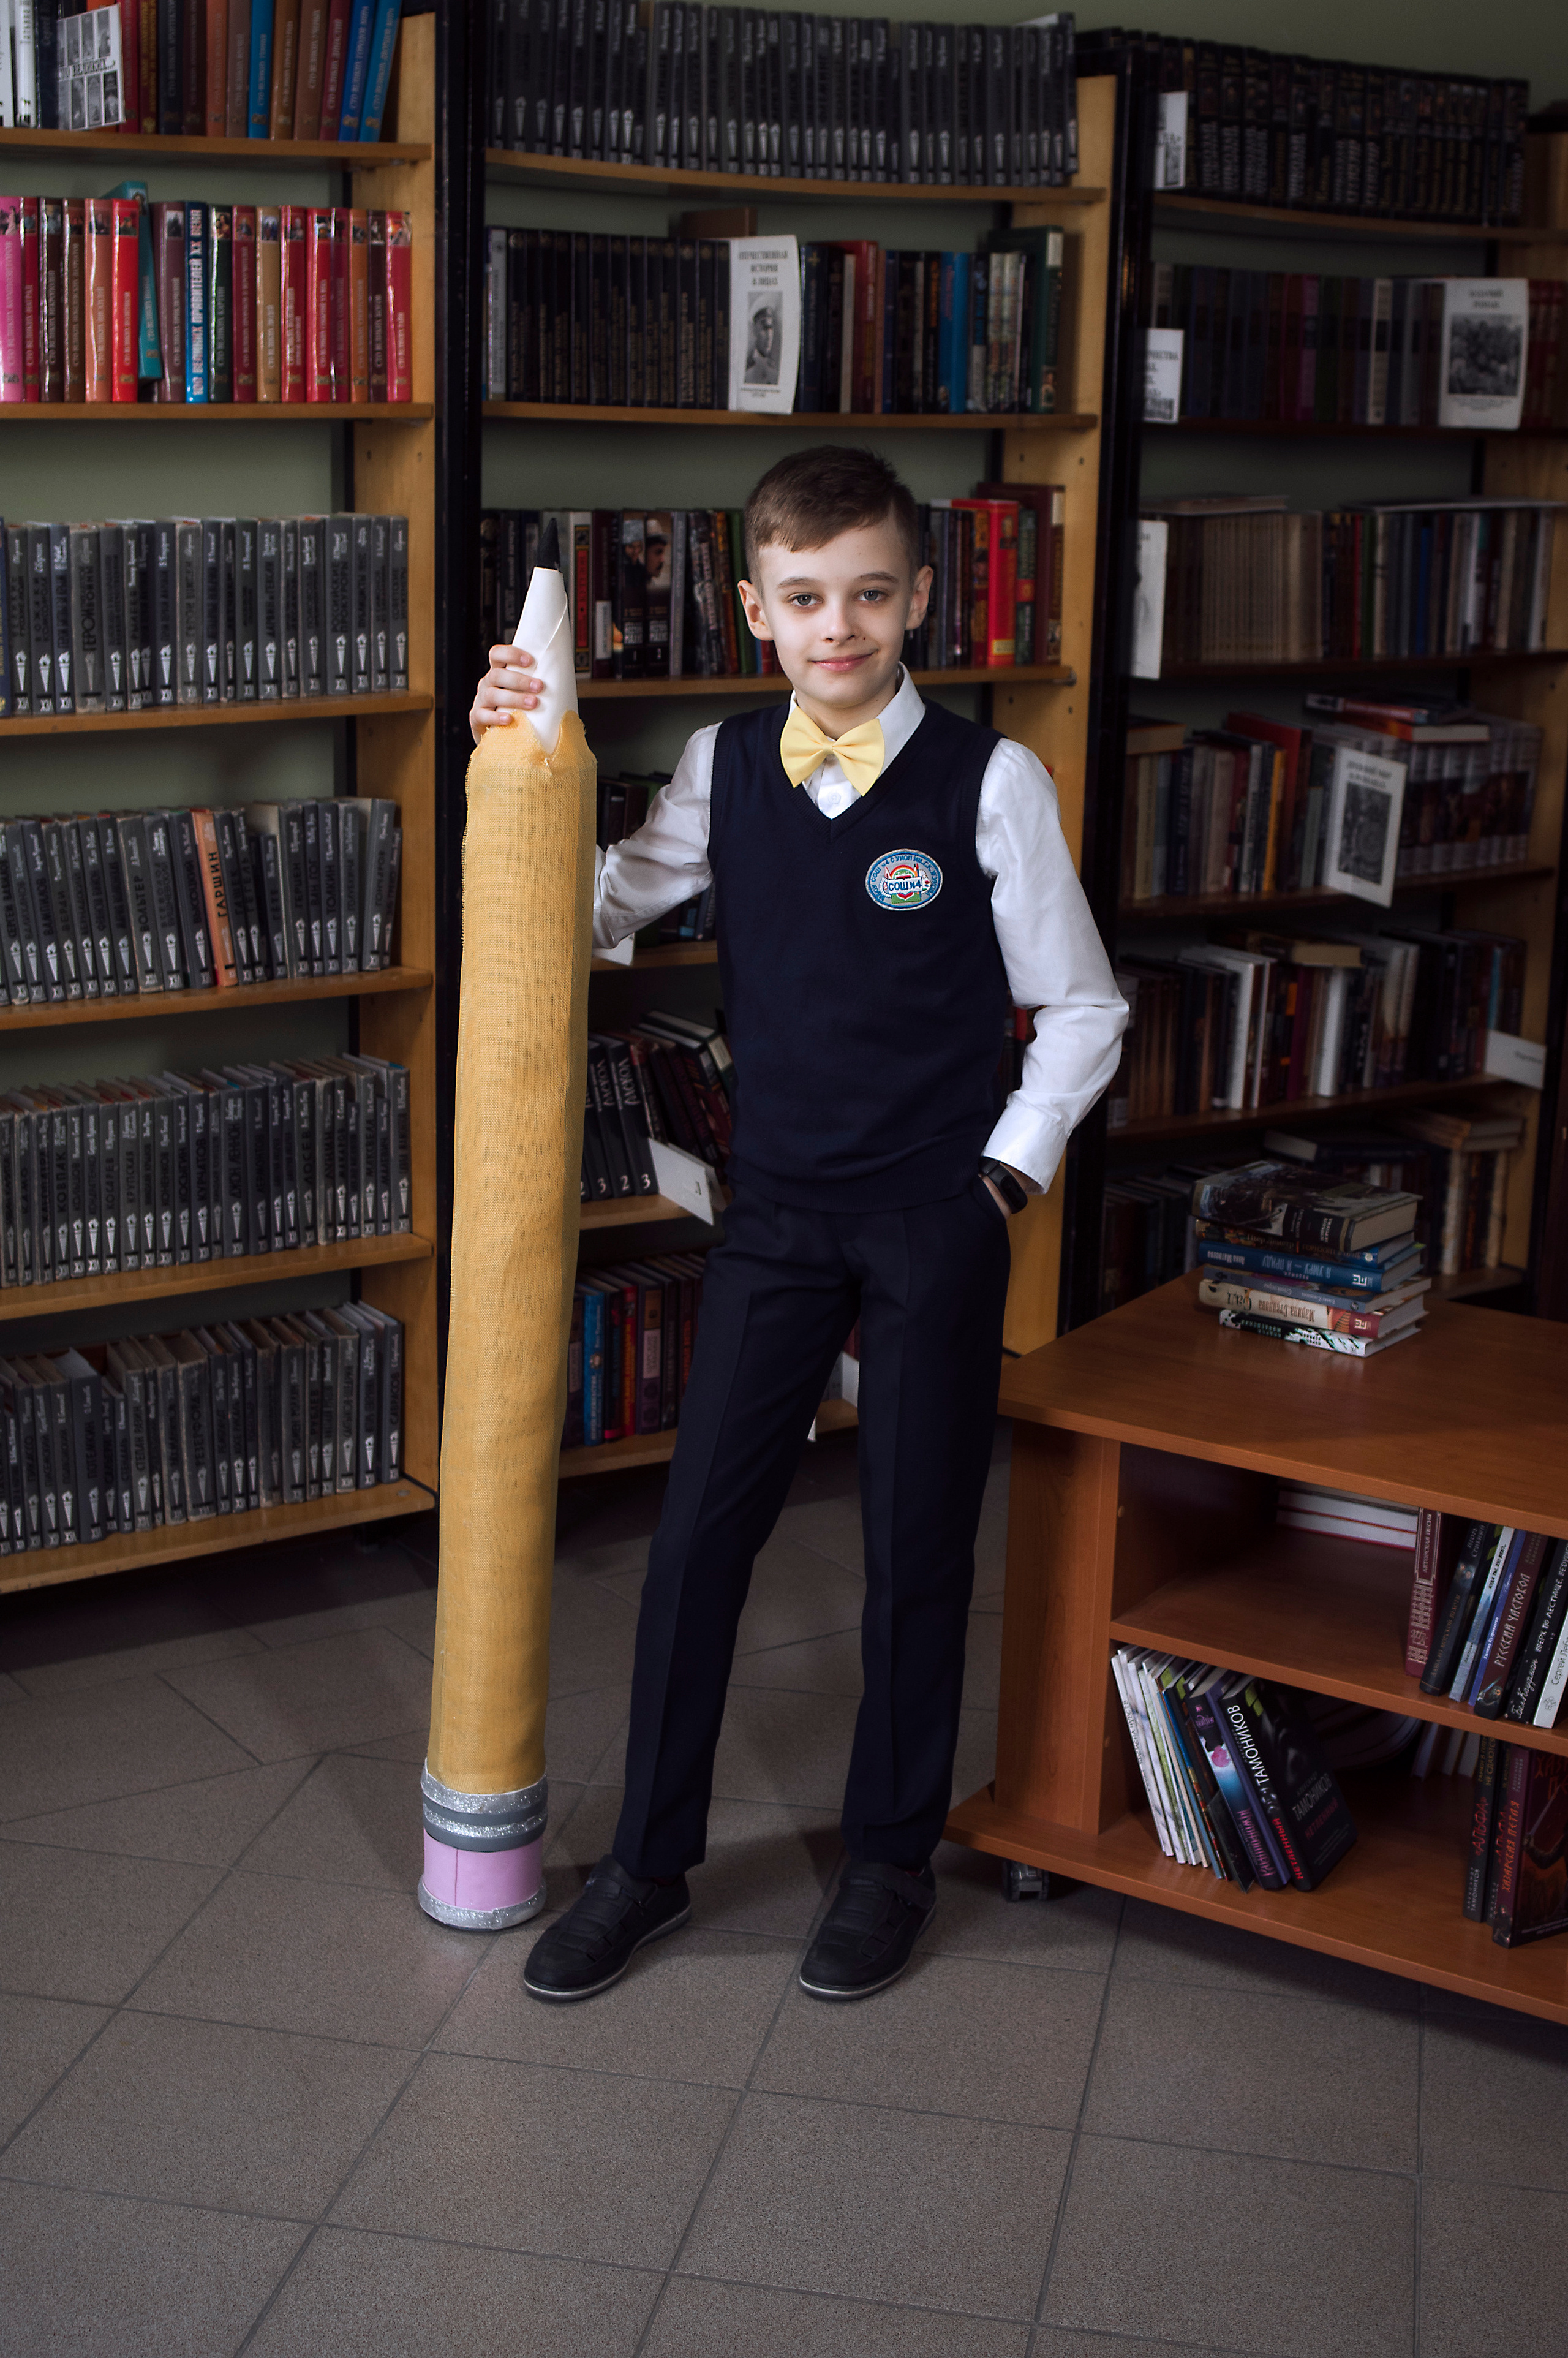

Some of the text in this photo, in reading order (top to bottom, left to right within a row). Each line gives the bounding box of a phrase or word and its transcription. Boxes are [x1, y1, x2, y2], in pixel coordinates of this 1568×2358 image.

[188, 259, 203, 323] ПРАВИТЕЛЕЙ
[192, 326, 203, 373] ВЕЛИКИХ
[192, 377, 203, 396] 100
[134, 875, 149, 931] ВОЛЬТЕР
[208, 852, 227, 917] ГАРШИН
[325, 865, 336, 914] ТОЛКИН
[888, 880, 908, 891] СОШ
[56, 1152, 67, 1213] КОВПАК
[197, 1138, 206, 1201] КУРЧАТОВ
[302, 1132, 312, 1184] ЛОСЕВ
[640, 1173, 651, 1190] 3
[1262, 1254, 1284, 1270] ПРИДУ
[1287, 1260, 1292, 1271] И
[1325, 1267, 1331, 1278] Я
[1259, 1300, 1315, 1323] Марина Степнова
[191, 1396, 205, 1466] РЕЗЕРФОРД
[1494, 1623, 1517, 1666] РУССКИЙ
[1506, 1573, 1531, 1622] ЧАСТОКОЛ
[1535, 1631, 1547, 1653] ВВЕРХ
[1545, 1579, 1564, 1619] ЛЕСТНИЦЕ,
[1551, 1658, 1566, 1685] Сергей
[1227, 1704, 1270, 1786] ТАМОНИКОВ
[1292, 1772, 1332, 1821] ТАМОНИКОВ
